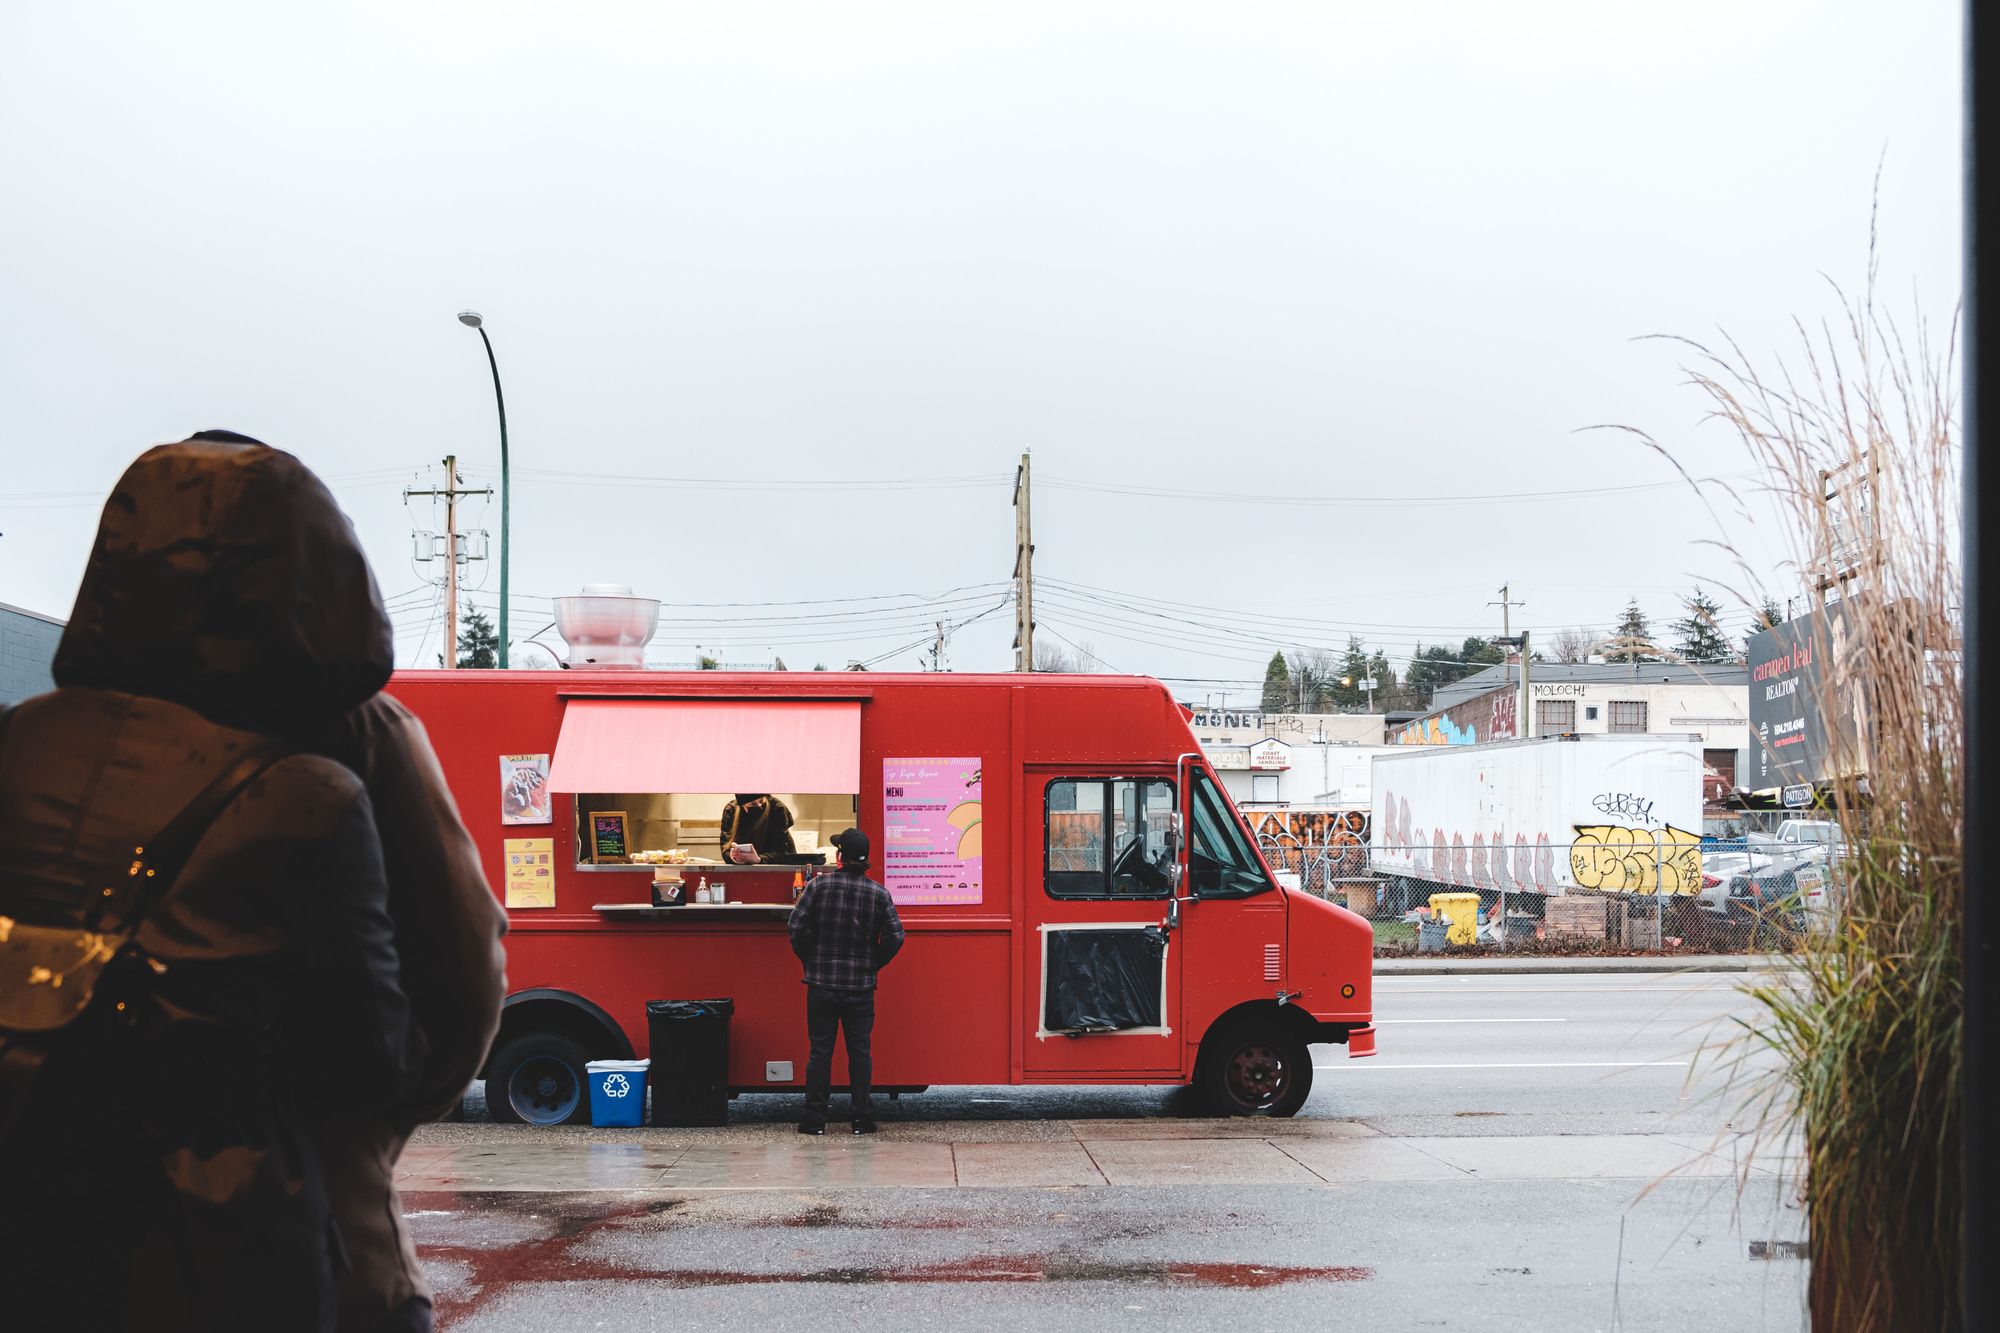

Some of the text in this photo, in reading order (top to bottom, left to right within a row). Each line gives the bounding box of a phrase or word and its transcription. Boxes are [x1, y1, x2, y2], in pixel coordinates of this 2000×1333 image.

[1753, 636, 1812, 681] carmen leal
[1195, 713, 1266, 729] MONET
[886, 787, 904, 797] MENU
[1786, 788, 1811, 802] PATTISON
